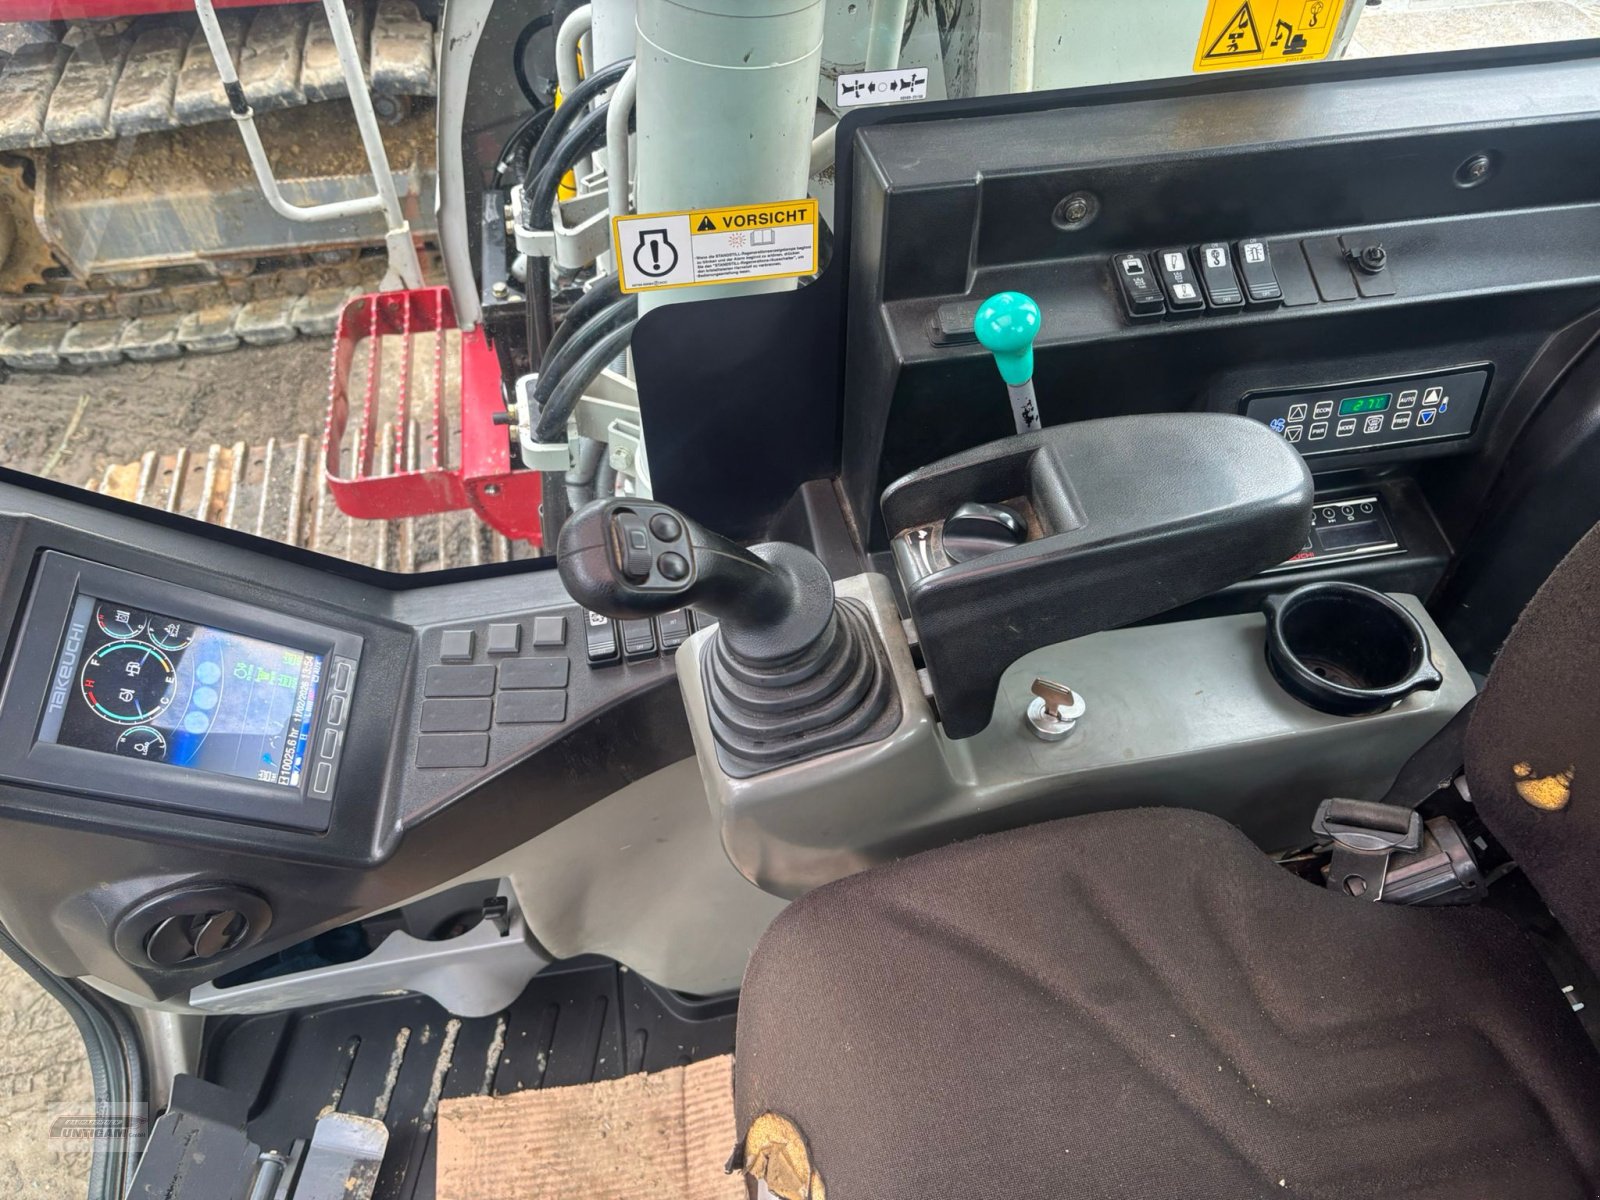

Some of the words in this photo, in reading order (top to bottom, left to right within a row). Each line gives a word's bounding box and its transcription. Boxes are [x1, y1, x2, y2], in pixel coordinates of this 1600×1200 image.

[722, 209, 808, 228] VORSICHT
[90, 658, 101, 666] F
[84, 679, 96, 688] H
[165, 676, 175, 684] E
[160, 696, 170, 704] C
